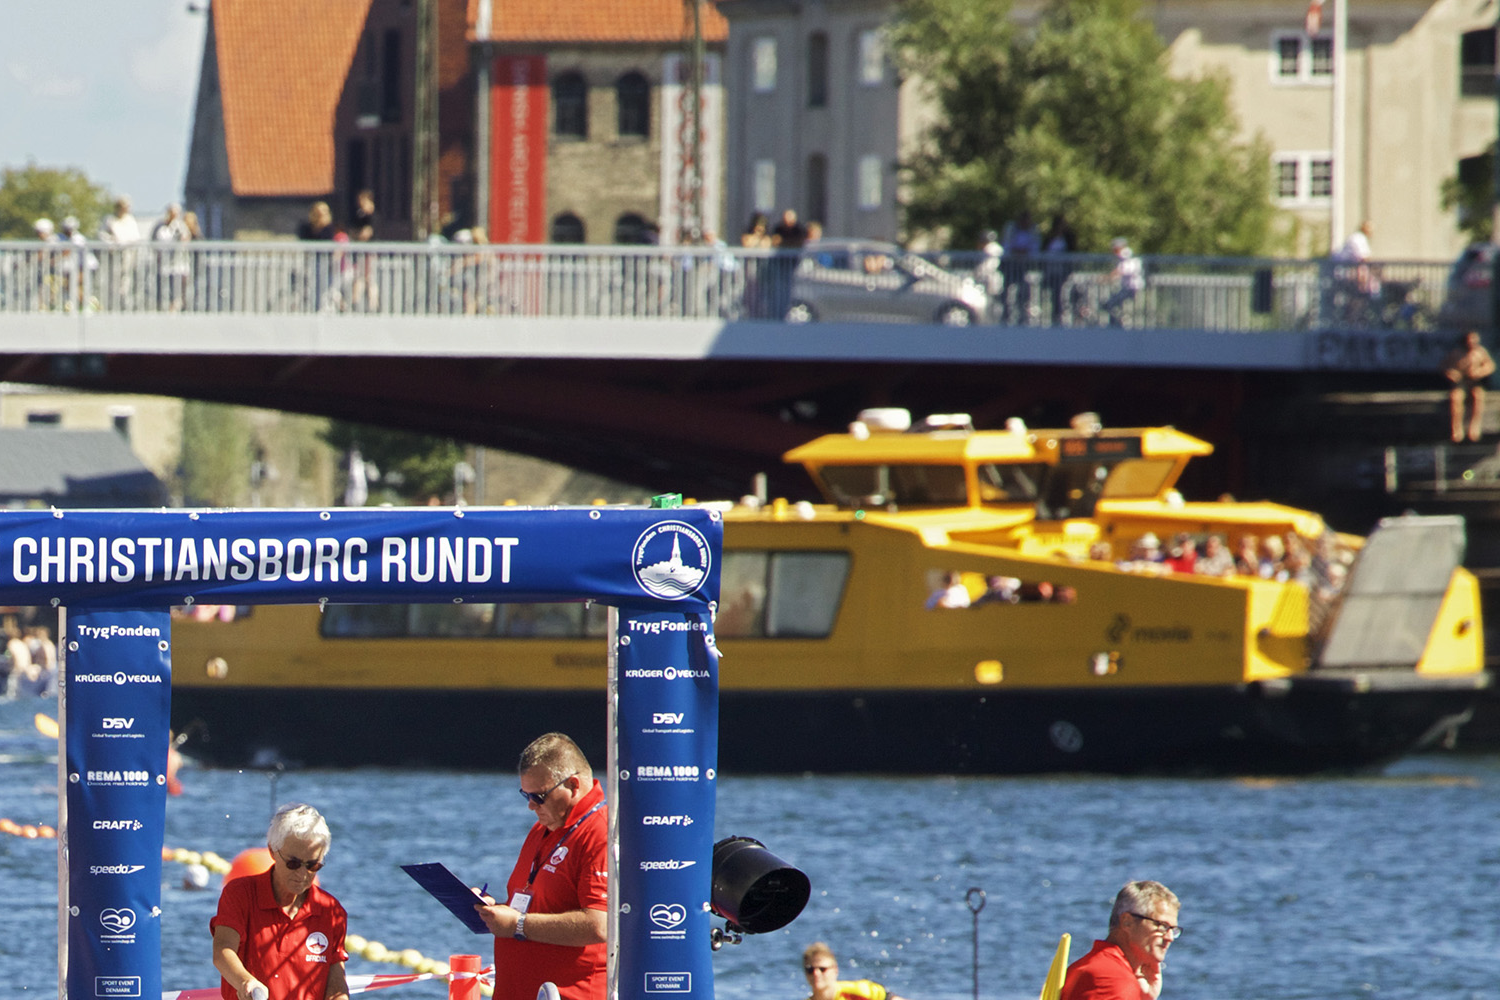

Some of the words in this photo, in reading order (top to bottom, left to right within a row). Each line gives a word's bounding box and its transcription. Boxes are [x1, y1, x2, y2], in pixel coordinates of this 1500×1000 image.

[13, 537, 367, 582] CHRISTIANSBORG
[382, 537, 518, 583] RUNDT
[78, 625, 160, 640] TrygFonden
[628, 620, 707, 635] TrygFonden
[75, 674, 112, 683] KRÜGER
[127, 675, 162, 683] VEOLIA
[625, 669, 662, 678] KRÜGER
[677, 670, 710, 678] VEOLIA
[102, 718, 134, 729] DSV
[653, 713, 684, 724] DSV
[87, 771, 121, 782] REMA
[122, 771, 148, 782] 1000
[637, 766, 671, 777] REMA
[672, 766, 699, 777] 1000
[92, 821, 132, 830] CRAFT
[642, 816, 683, 825] CRAFT
[90, 864, 128, 876] speedo
[640, 859, 679, 872] speedo
